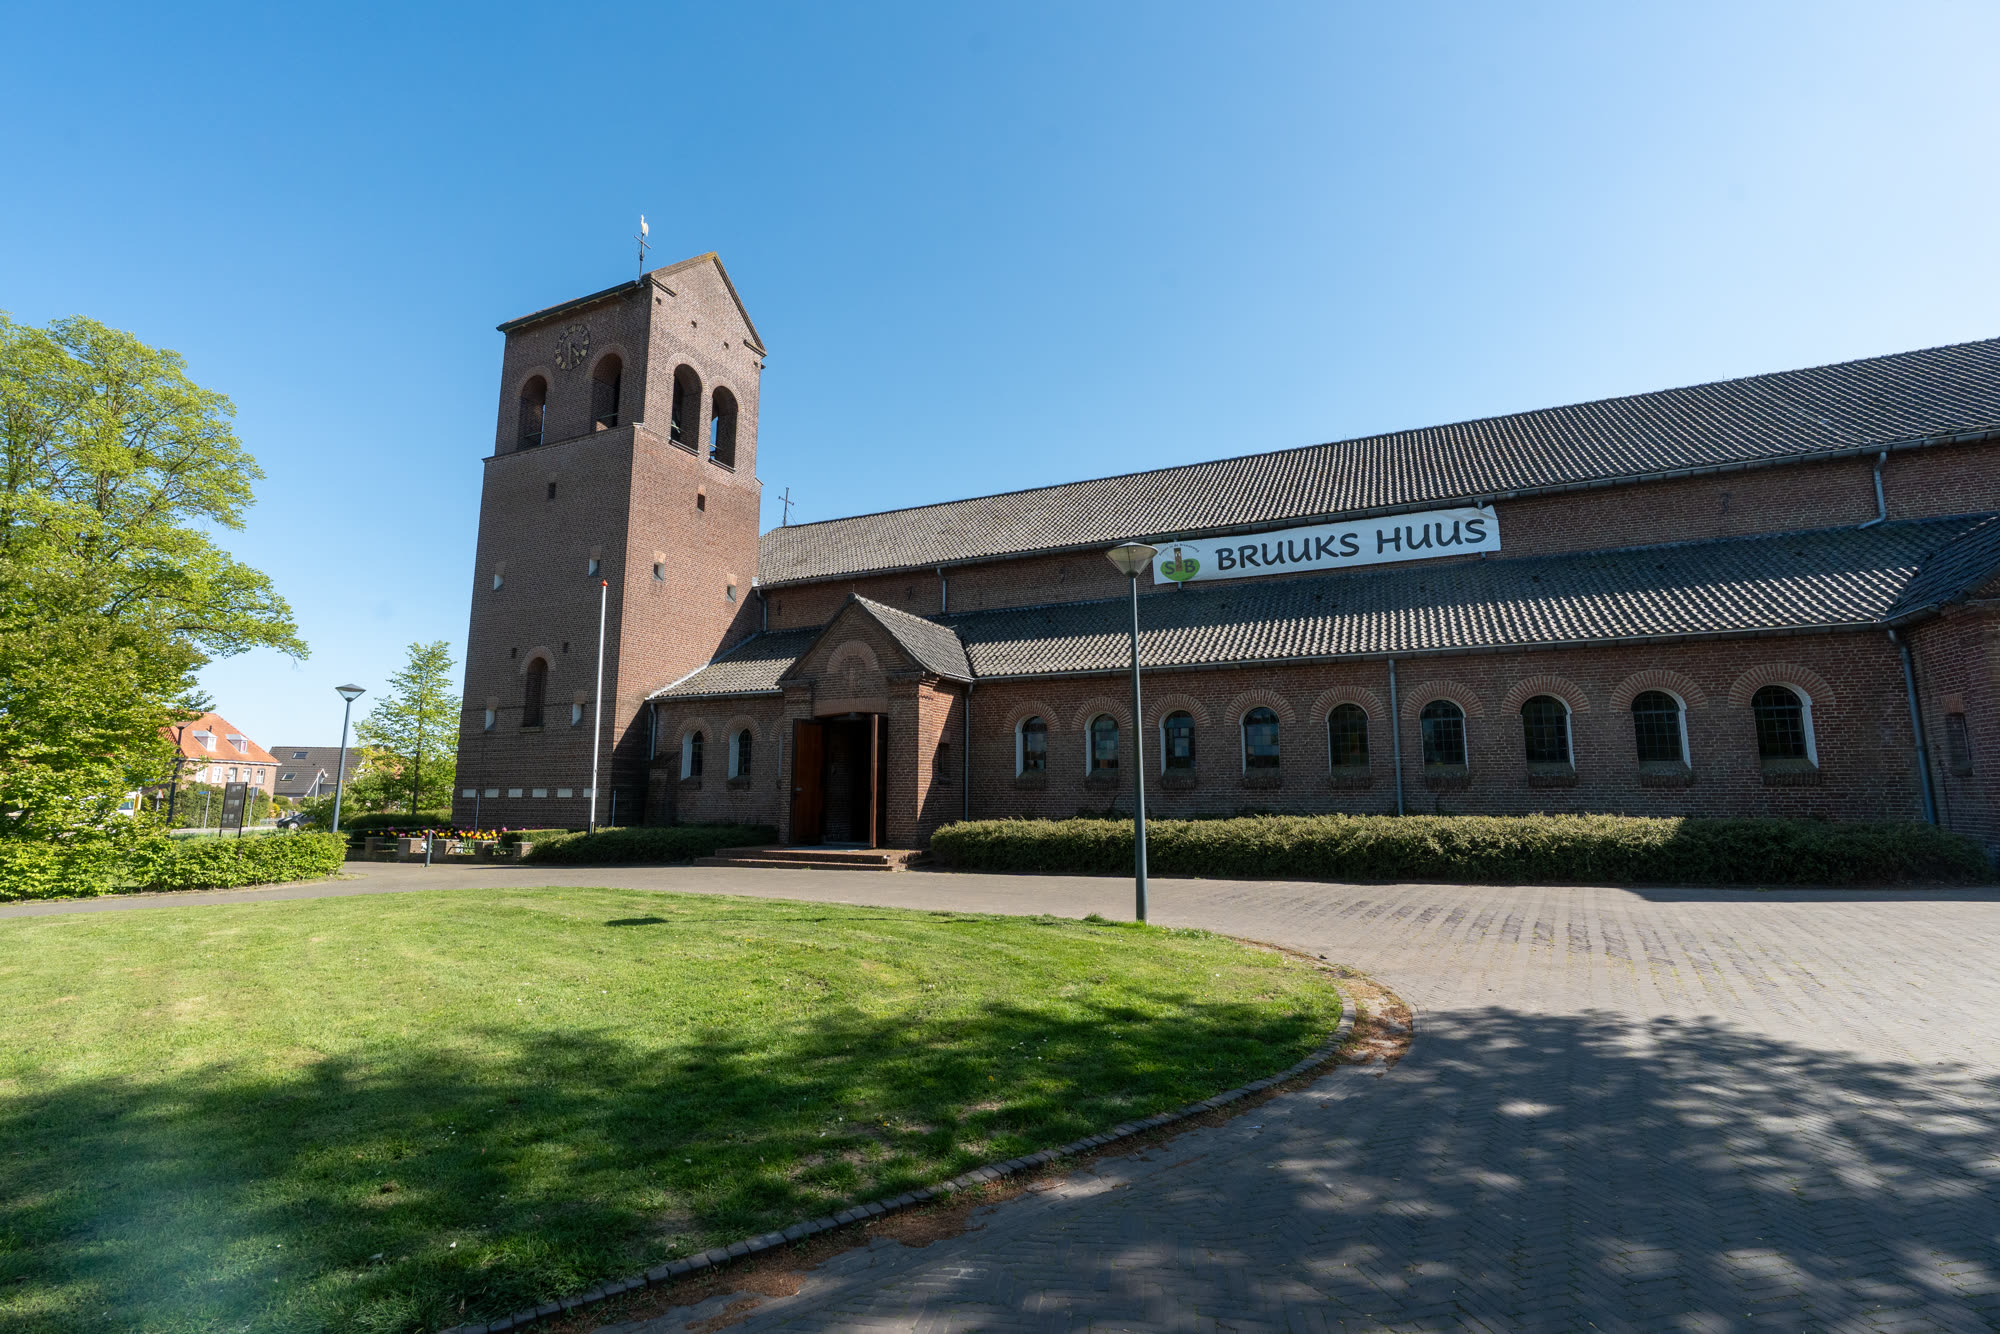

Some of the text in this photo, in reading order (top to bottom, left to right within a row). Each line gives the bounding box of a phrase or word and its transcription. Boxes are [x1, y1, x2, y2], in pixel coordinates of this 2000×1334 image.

[1215, 519, 1487, 571] BRUUKS HUUS
[1165, 560, 1196, 575] S B
